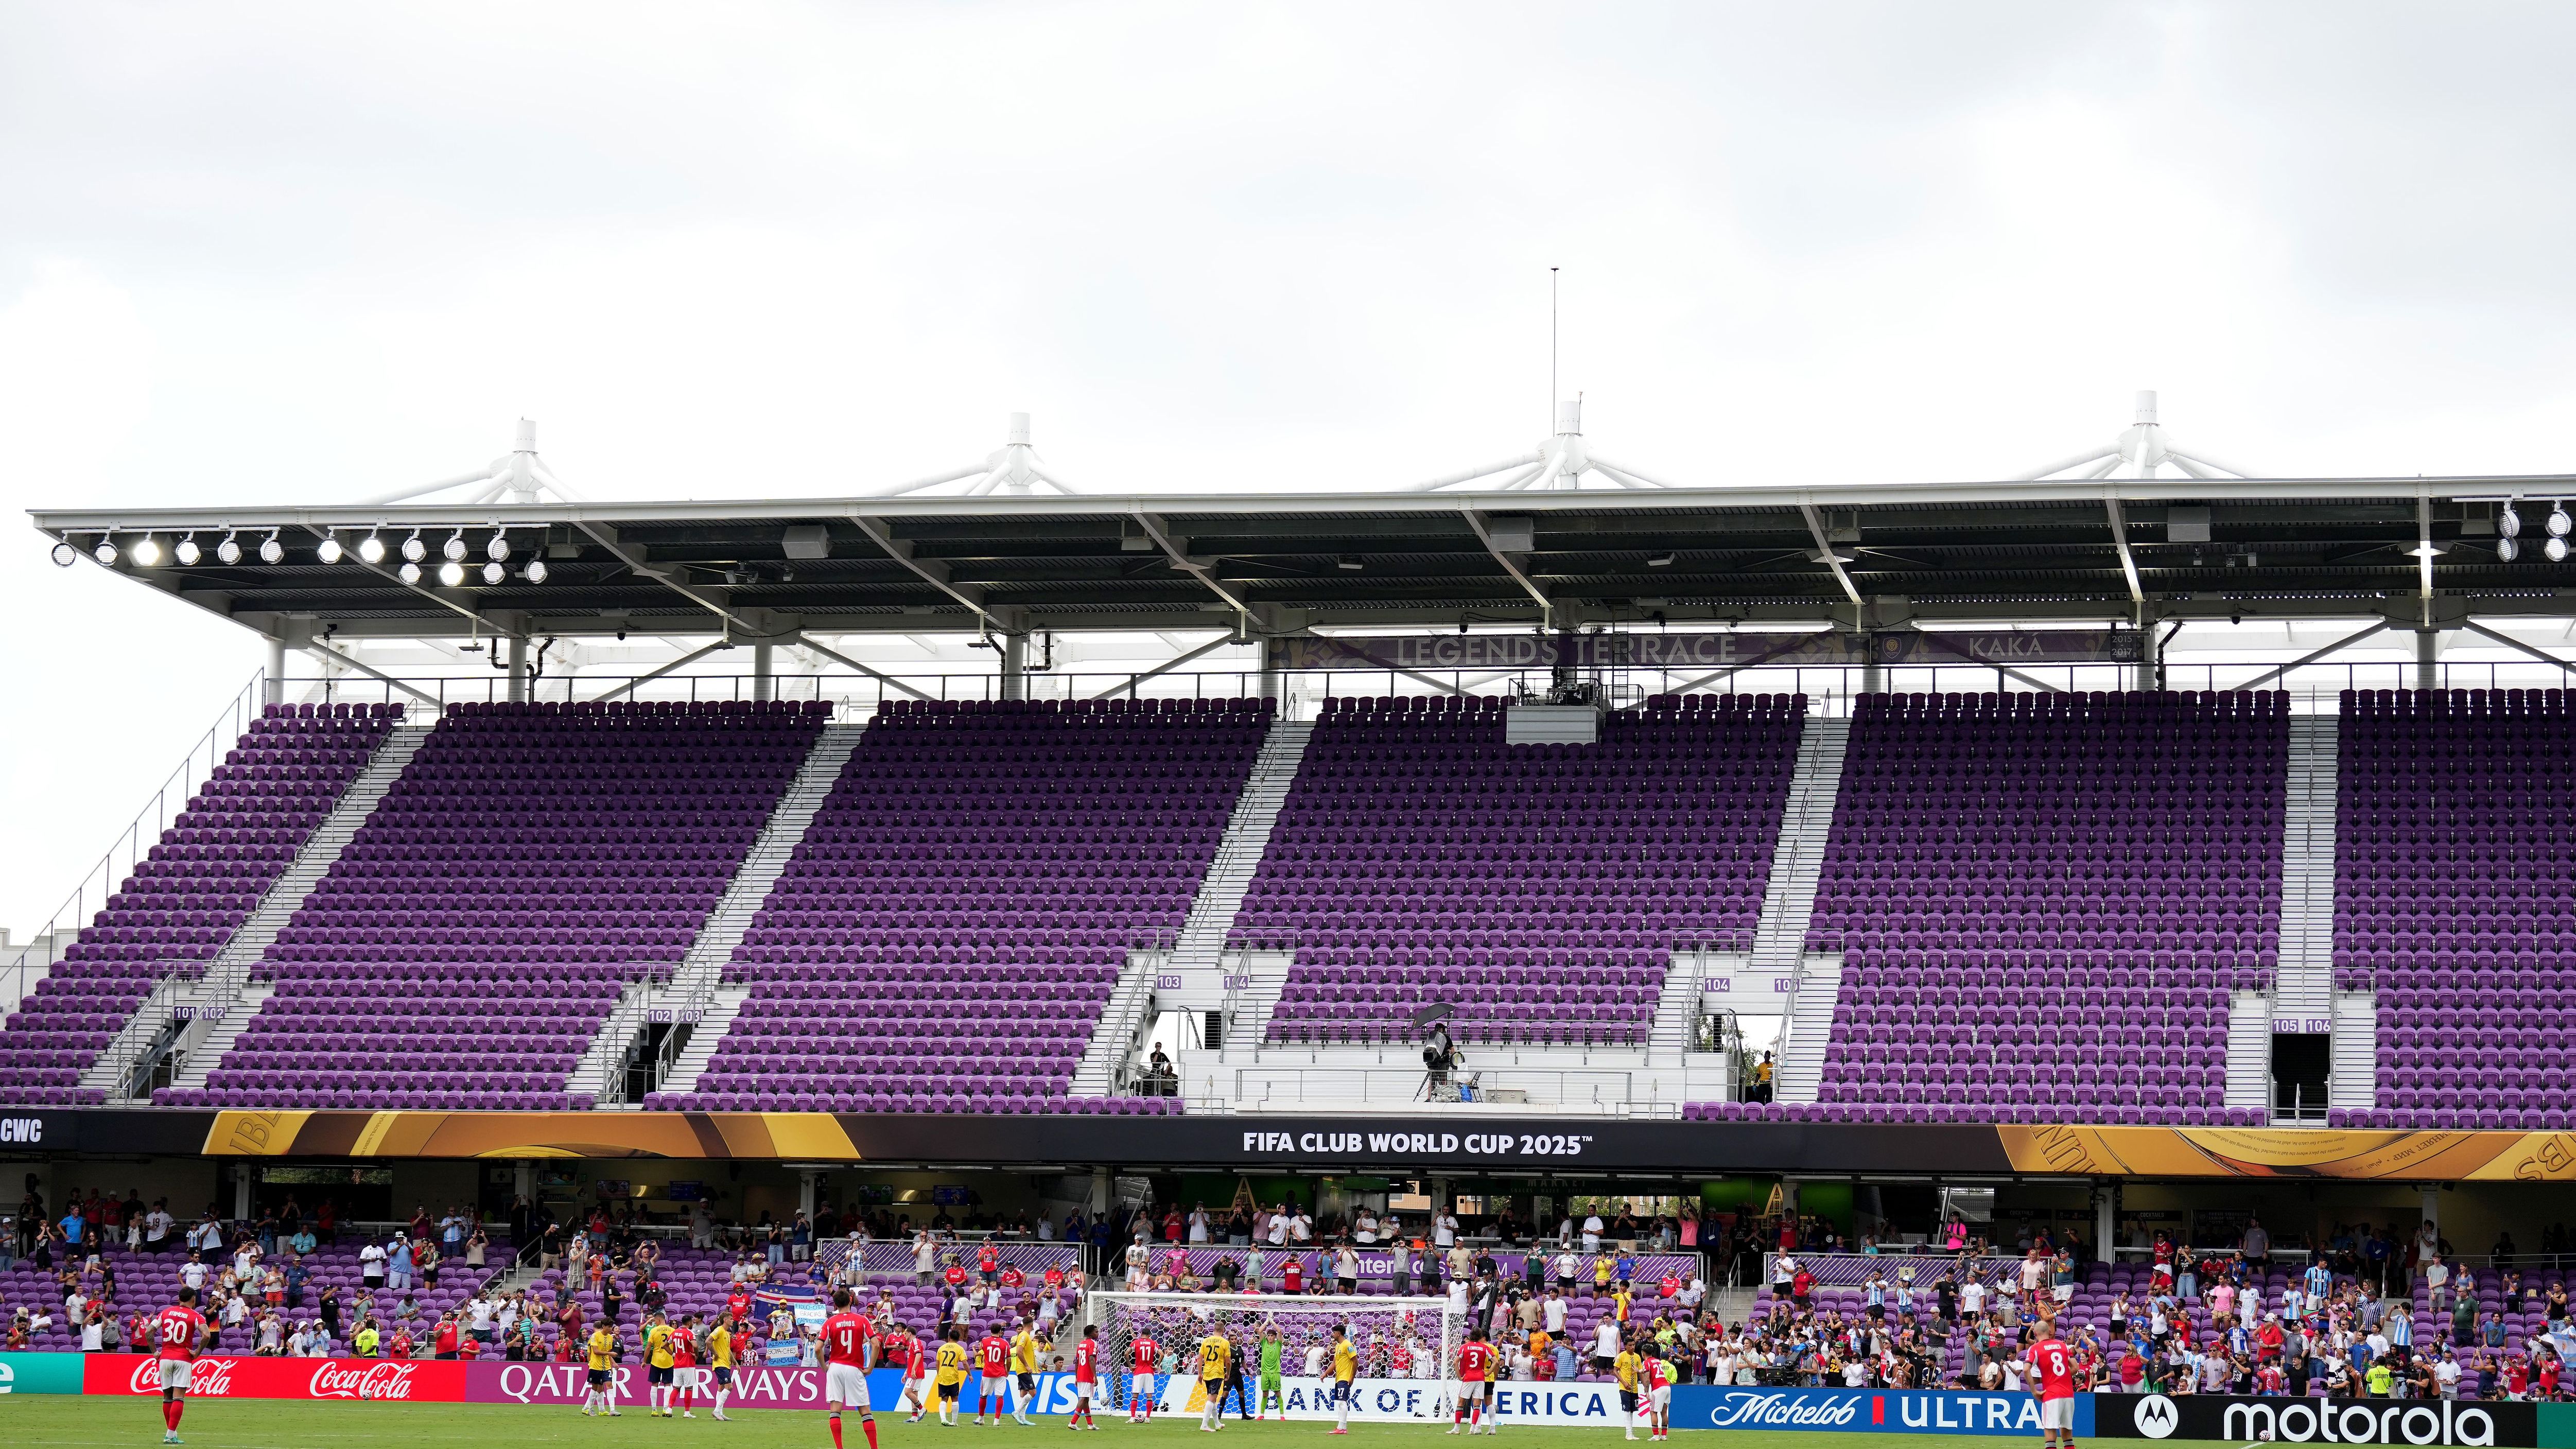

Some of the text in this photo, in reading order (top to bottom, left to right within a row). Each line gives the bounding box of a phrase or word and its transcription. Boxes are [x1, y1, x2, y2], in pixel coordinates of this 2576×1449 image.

[1397, 635, 1736, 666] LEGENDS TERRACE
[1969, 632, 2045, 656] KAKÁ
[1158, 976, 1180, 987] 103
[1706, 979, 1729, 990] 104
[176, 1007, 195, 1019] 101
[204, 1007, 224, 1019] 102
[649, 1010, 670, 1021] 102
[2273, 1020, 2297, 1032] 105
[2307, 1020, 2330, 1032] 106
[1, 1118, 42, 1142] CWC
[1243, 1132, 1291, 1152] FIFA
[1300, 1132, 1363, 1153] CLUB
[1368, 1133, 1460, 1154] WORLD
[1464, 1134, 1515, 1155] CUP
[2220, 1136, 2229, 1144] shall
[2237, 1141, 2253, 1151] opposing
[163, 1318, 187, 1344] 30
[673, 1338, 686, 1354] 14
[841, 1330, 852, 1354] 4
[941, 1350, 956, 1368] 22
[986, 1346, 1001, 1363] 10
[1077, 1349, 1086, 1367] 18
[1139, 1346, 1151, 1361] 11
[1206, 1345, 1220, 1362] 25
[1469, 1351, 1479, 1368] 3
[1829, 1364, 1840, 1373] 22
[2050, 1351, 2066, 1376] 8
[310, 1361, 420, 1399] Coca-Cola
[1337, 1388, 1345, 1396] 27
[1376, 1388, 1424, 1412] OF
[1438, 1391, 1606, 1416] ERICA
[1711, 1392, 2043, 1430] Michelob ULTRA
[2224, 1397, 2495, 1447] motorola
